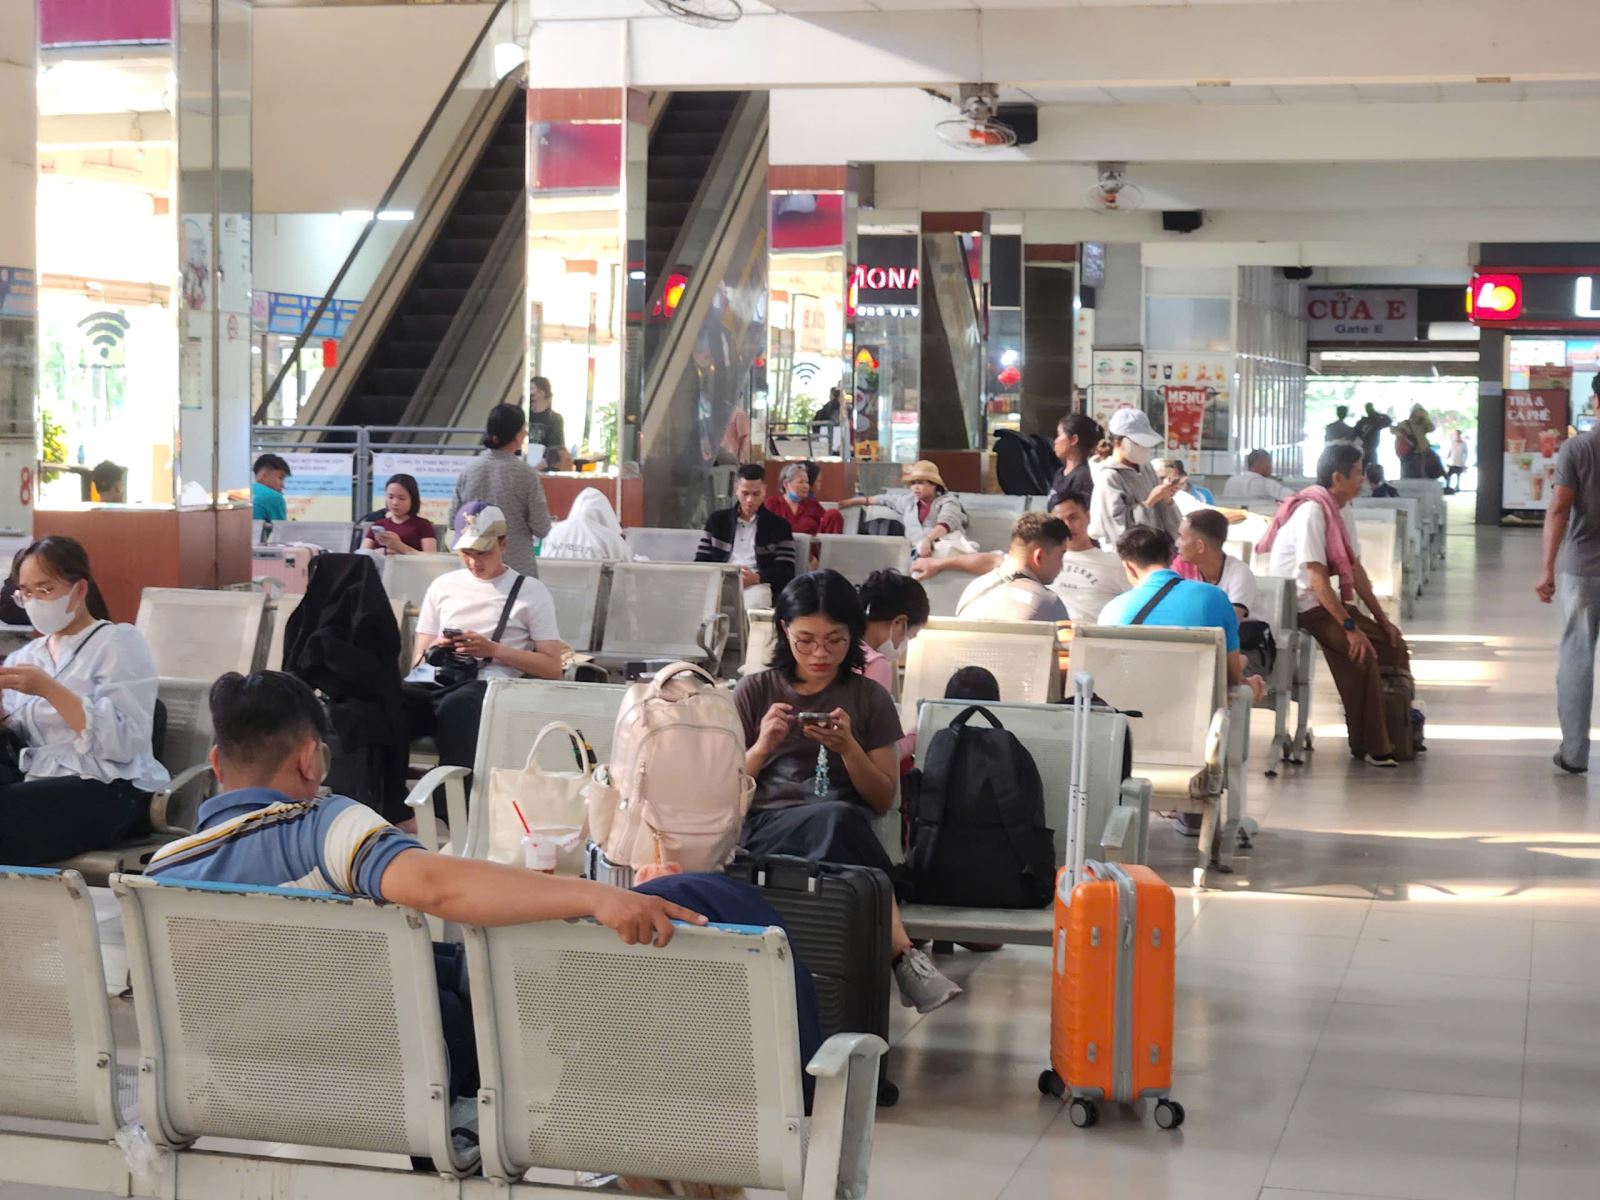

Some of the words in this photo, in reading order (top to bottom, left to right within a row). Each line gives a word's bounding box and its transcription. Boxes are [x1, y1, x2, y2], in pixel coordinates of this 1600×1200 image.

[1307, 291, 1373, 320] CỬA
[1385, 299, 1408, 320] E
[1334, 323, 1370, 335] Gate
[1373, 323, 1384, 334] E
[1167, 389, 1206, 405] MENU
